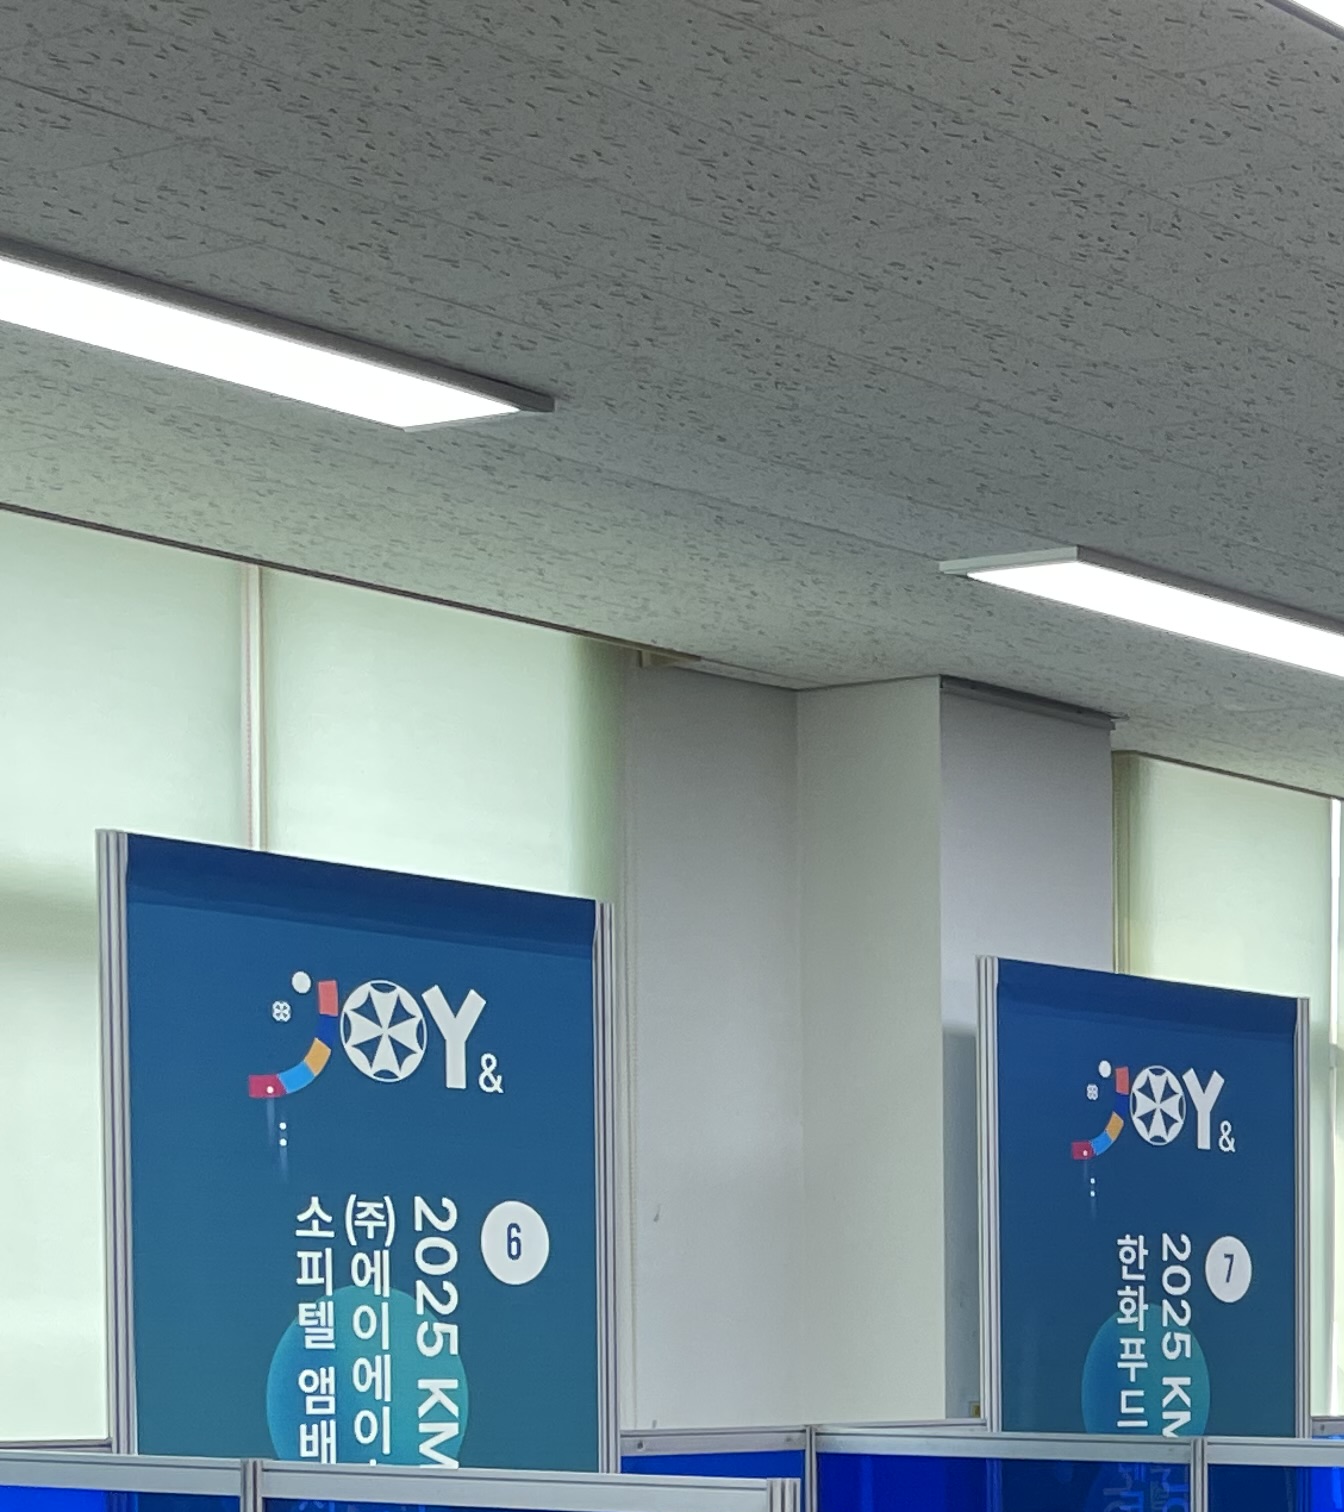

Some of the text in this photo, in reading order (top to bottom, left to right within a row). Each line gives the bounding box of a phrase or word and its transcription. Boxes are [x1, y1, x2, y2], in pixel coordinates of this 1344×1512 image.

[295, 1198, 334, 1349] 소피텔
[413, 1197, 458, 1357] 2025
[506, 1224, 521, 1259] 6
[1162, 1234, 1192, 1360] 2025
[1224, 1254, 1234, 1283] 7
